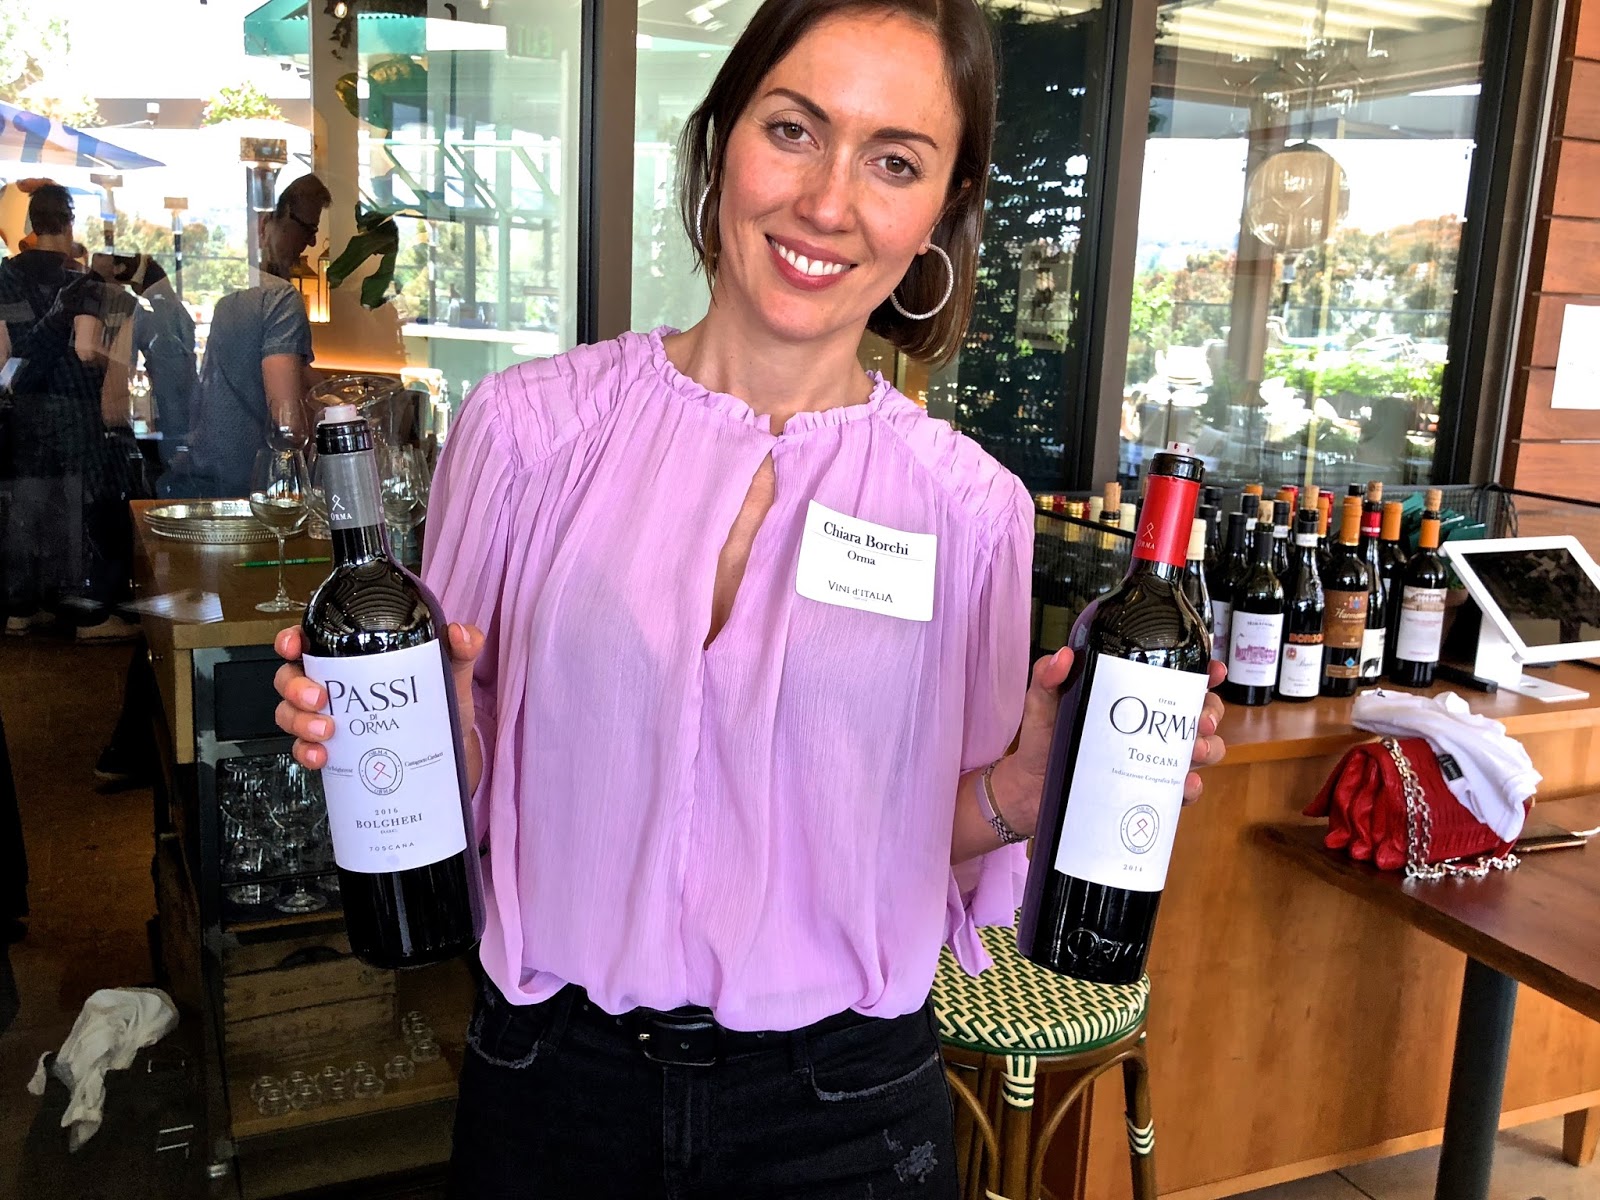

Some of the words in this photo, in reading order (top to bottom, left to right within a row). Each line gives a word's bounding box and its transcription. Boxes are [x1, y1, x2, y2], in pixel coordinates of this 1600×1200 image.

[824, 521, 861, 544] Chiara
[866, 534, 909, 555] Borchi
[1138, 540, 1155, 549] ORMA
[847, 550, 876, 565] Orma
[828, 580, 850, 594] VINI
[325, 675, 419, 716] PASSI
[349, 718, 400, 736] ORMA
[1109, 696, 1196, 744] ORMA
[1128, 747, 1178, 767] TOSCANA
[375, 808, 398, 816] 2016
[356, 813, 422, 829] BOLGHERI
[369, 842, 414, 852] TOSCANA
